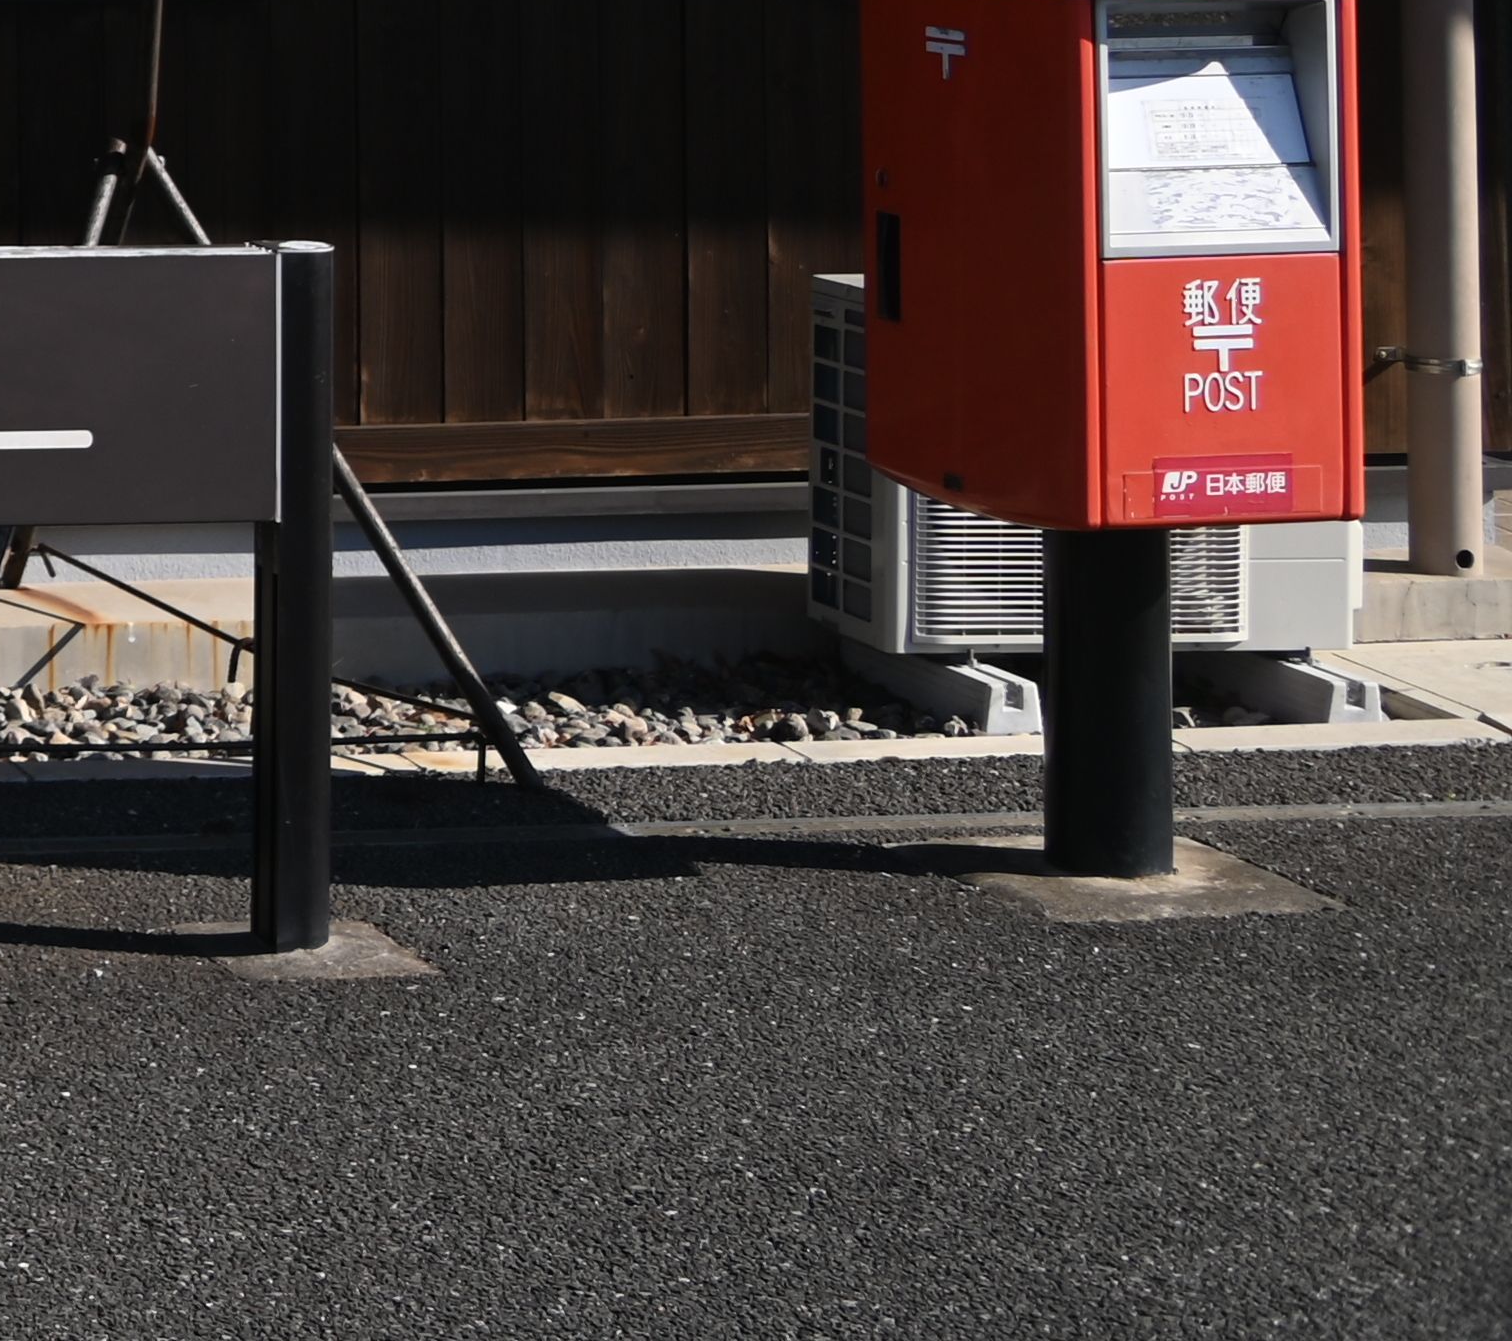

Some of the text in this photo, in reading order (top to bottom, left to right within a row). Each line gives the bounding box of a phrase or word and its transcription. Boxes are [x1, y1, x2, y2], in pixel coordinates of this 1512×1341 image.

[1183, 277, 1263, 326] 郵便
[1183, 370, 1264, 414] POST
[1206, 471, 1287, 496] 日本郵便
